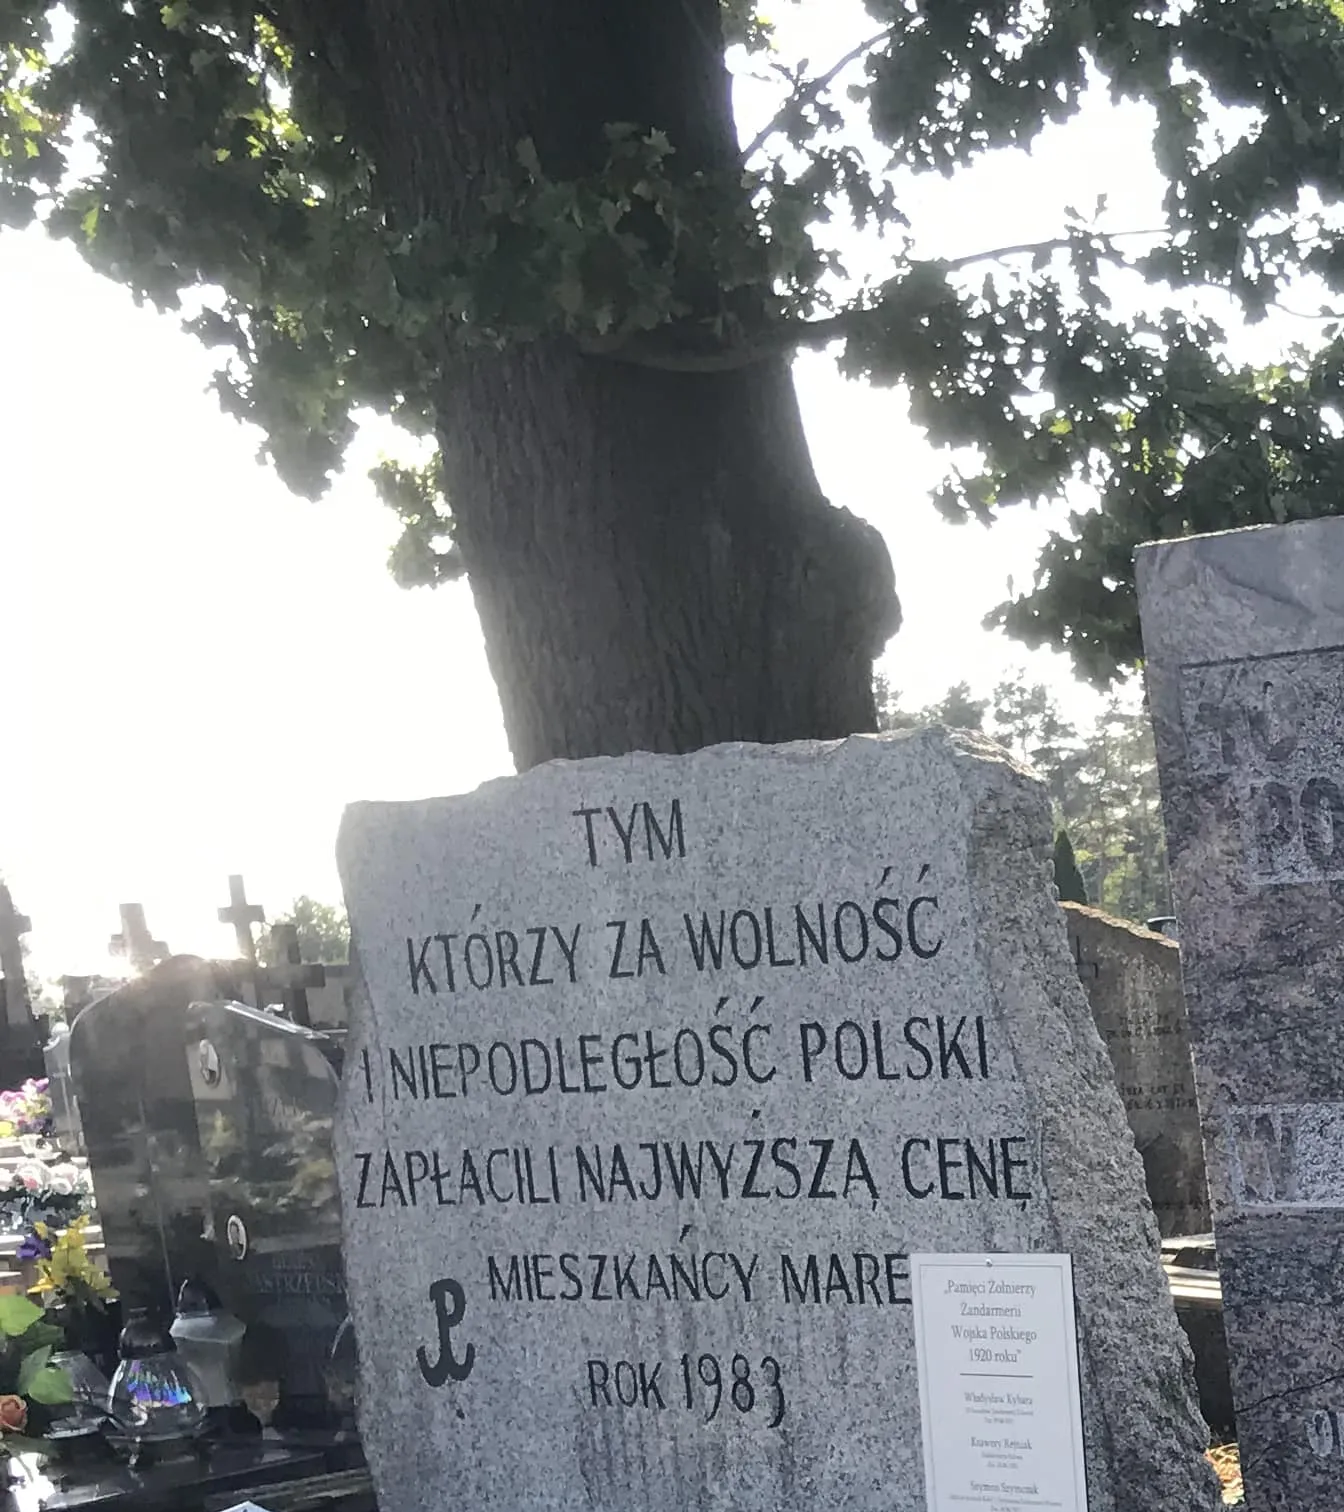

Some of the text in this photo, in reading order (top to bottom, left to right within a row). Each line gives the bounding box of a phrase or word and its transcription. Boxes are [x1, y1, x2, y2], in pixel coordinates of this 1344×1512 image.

[573, 800, 687, 867] TYM
[407, 863, 944, 997] KTÓRZY ZA WOLNOŚĆ
[362, 996, 990, 1105] I NIEPODLEGŁOŚĆ POLSKI
[355, 1108, 1035, 1212] ZAPŁACILI NAJWYŻSZĄ CENĘ
[488, 1223, 913, 1307] MIESZKAŃCY MARE
[951, 1325, 1038, 1344] Wojska Polskiego
[969, 1348, 993, 1362] 1920
[587, 1352, 786, 1430] ROK 1983
